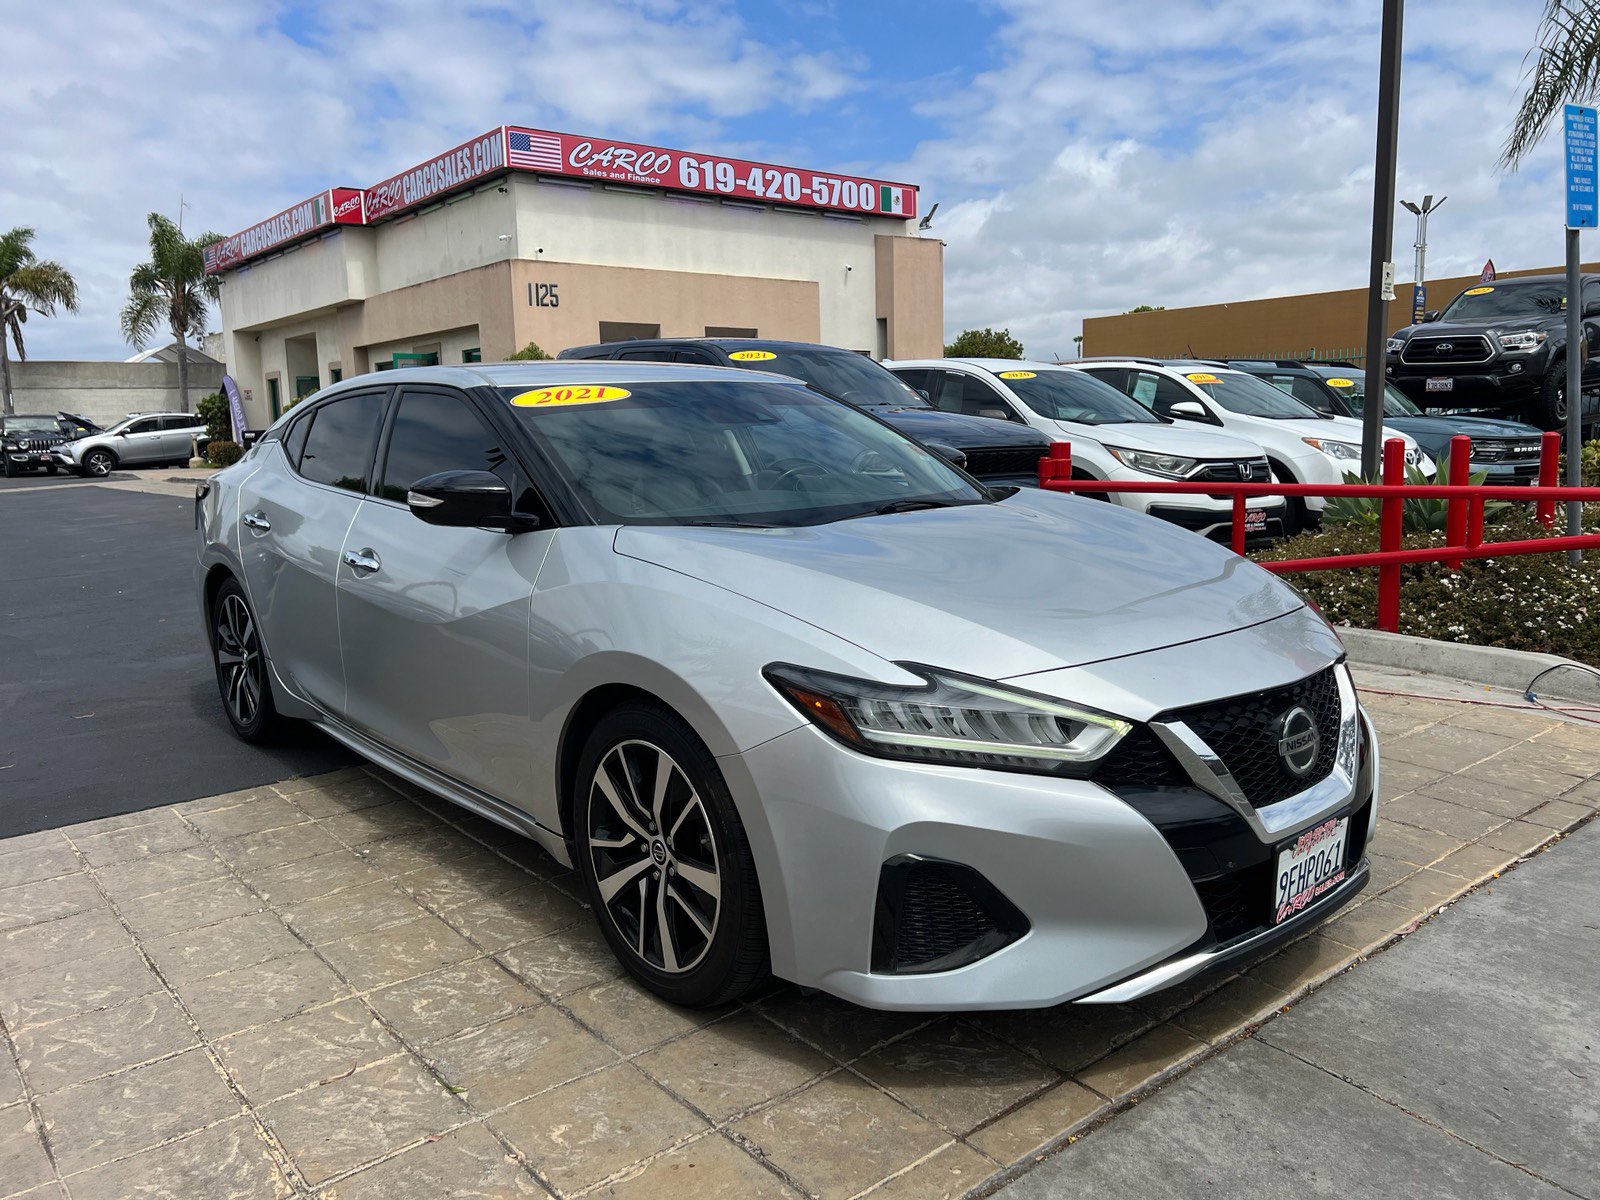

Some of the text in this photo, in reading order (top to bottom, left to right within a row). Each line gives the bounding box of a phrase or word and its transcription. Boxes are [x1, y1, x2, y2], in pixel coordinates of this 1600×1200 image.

[569, 142, 672, 176] CARCO
[365, 132, 503, 216] CARCO CARCOSALES.COM
[582, 167, 661, 184] Sales and Finance
[678, 156, 875, 210] 619-420-5700
[333, 196, 360, 217] CARCO
[240, 202, 314, 257] CARCOSALES.COM
[527, 282, 559, 307] 1125
[536, 387, 606, 405] 2021
[1286, 730, 1316, 751] NISSAN
